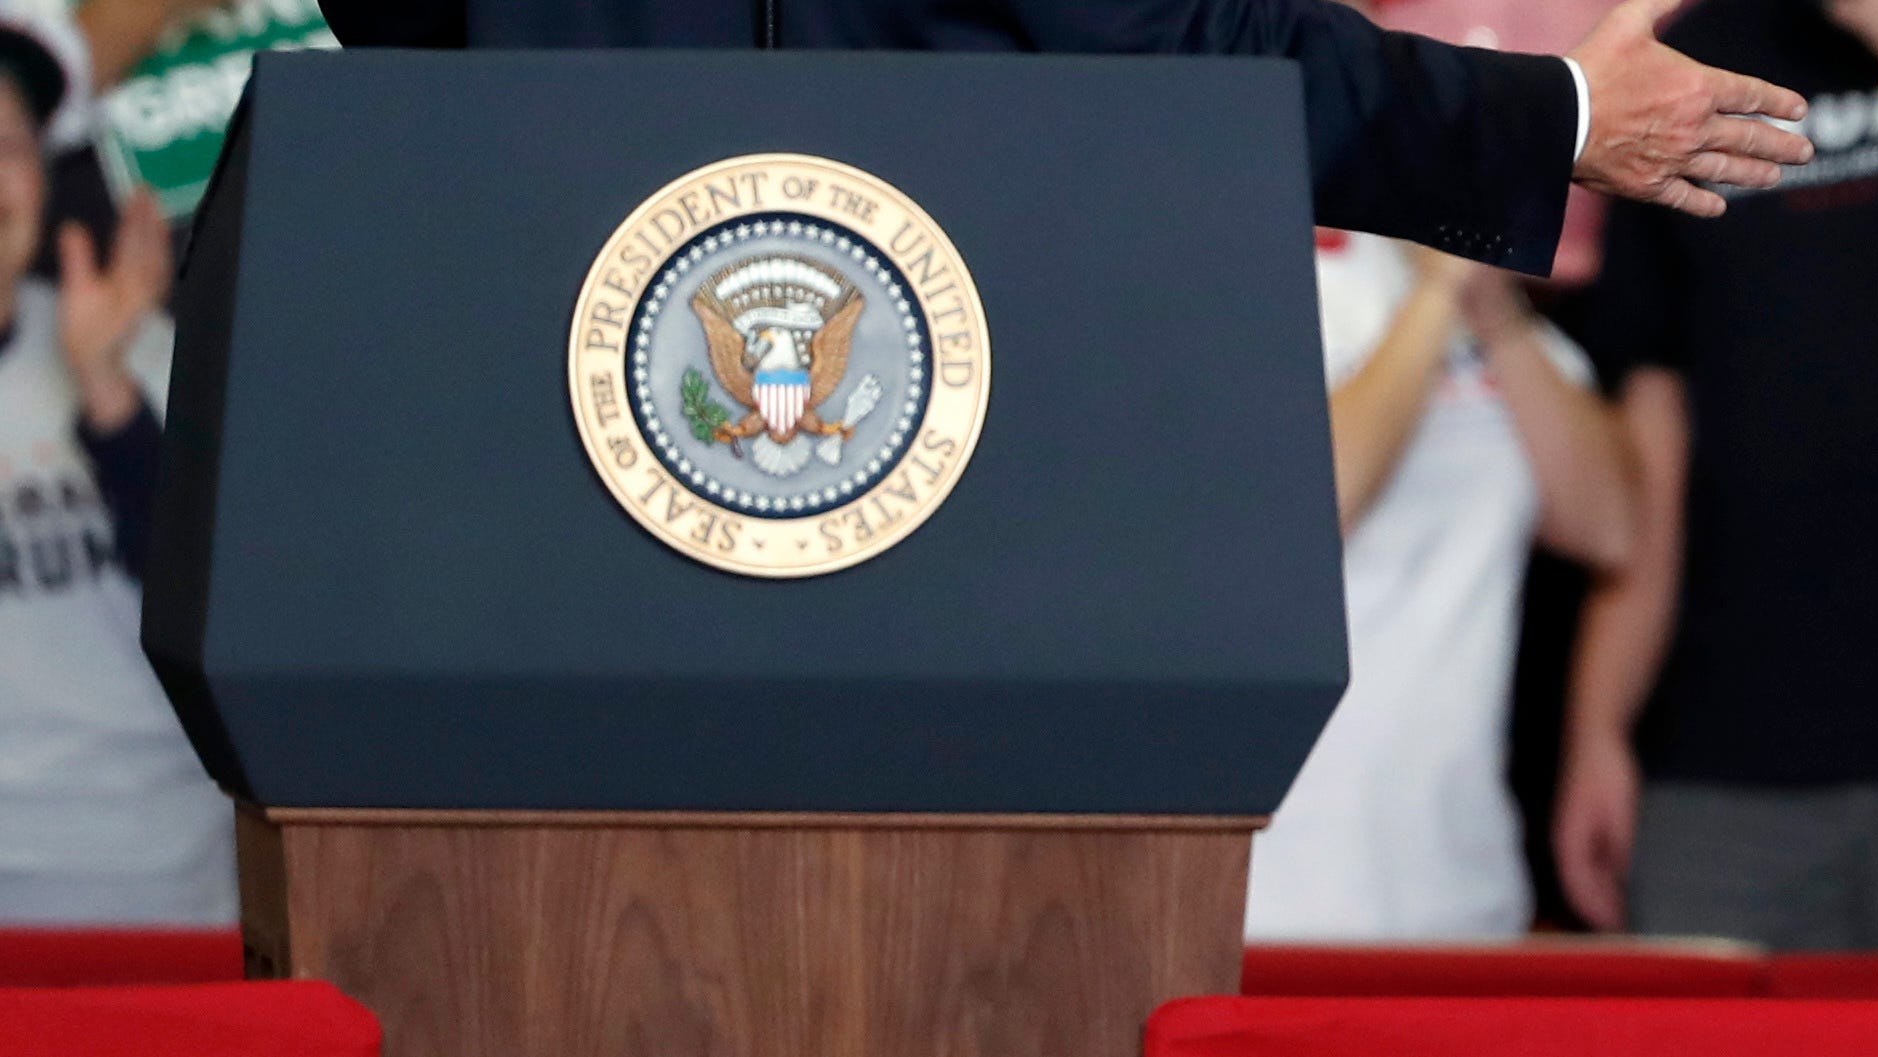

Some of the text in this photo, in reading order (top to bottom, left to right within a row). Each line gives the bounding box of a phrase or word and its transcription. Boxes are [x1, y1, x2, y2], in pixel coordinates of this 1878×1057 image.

[586, 170, 975, 553] SEAL OF THE PRESIDENT OF THE UNITED STATES
